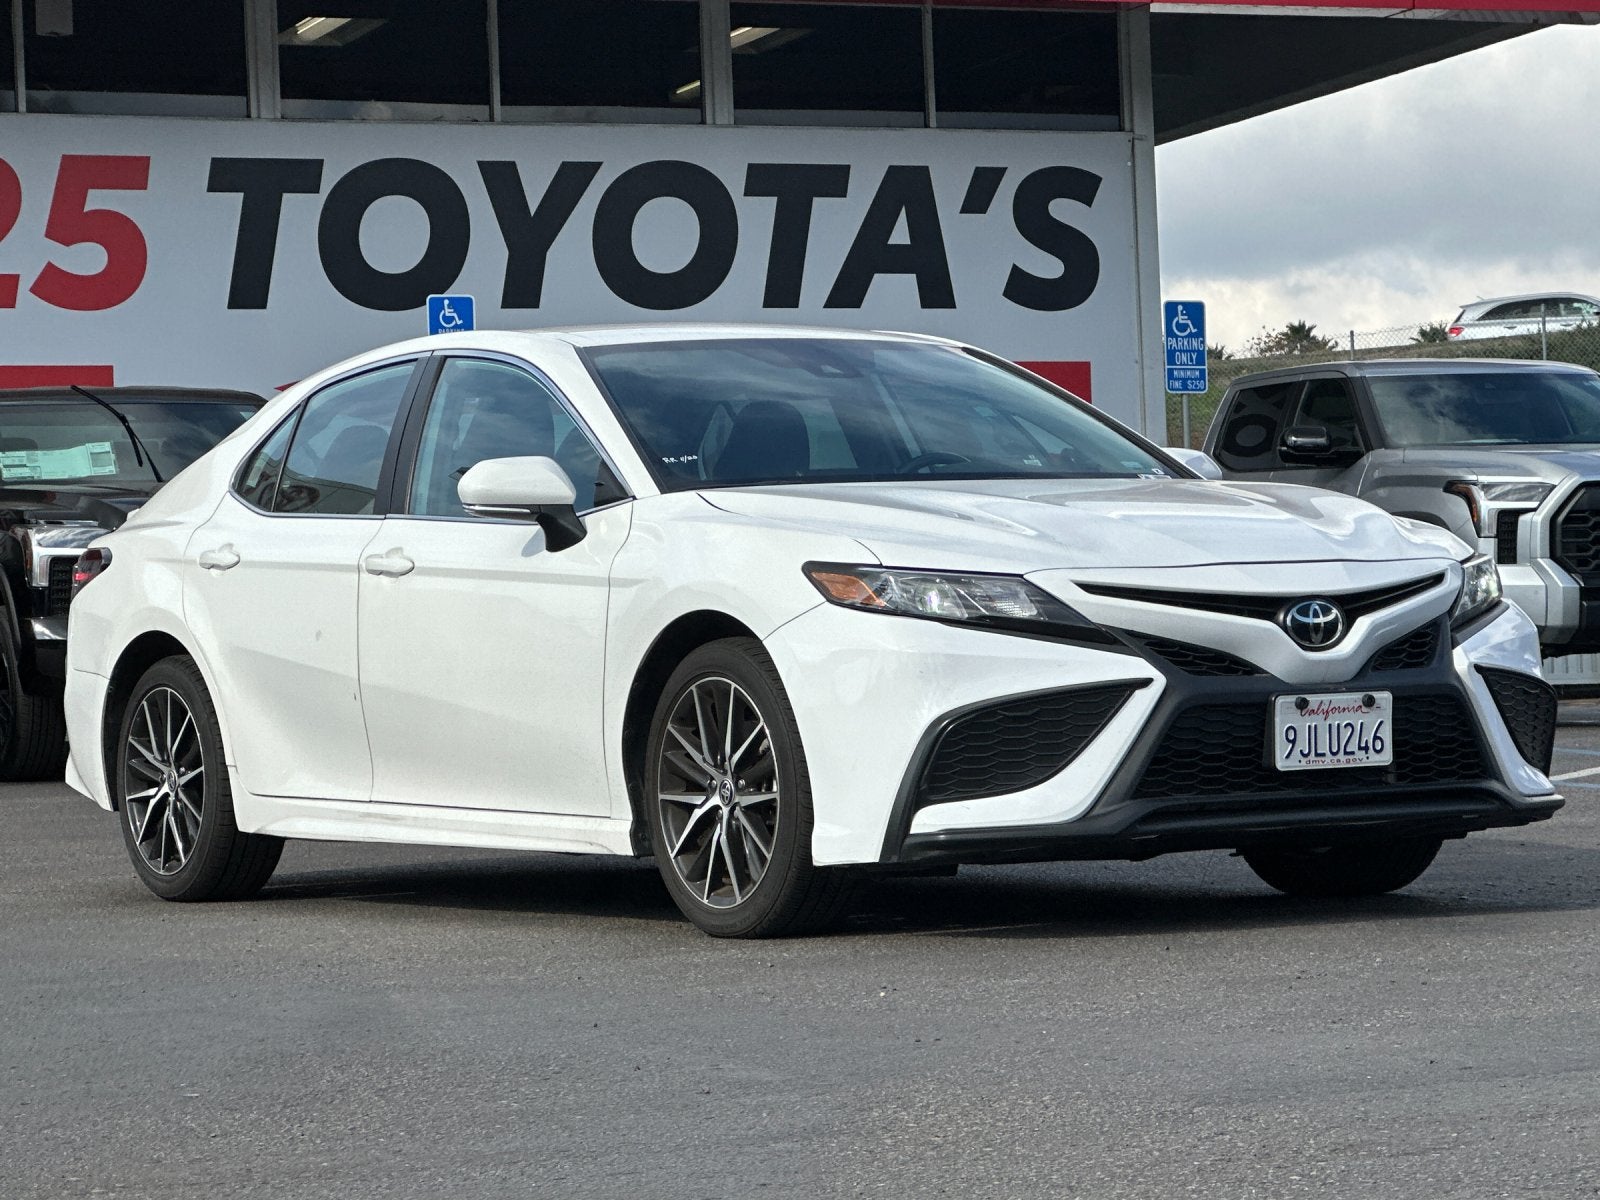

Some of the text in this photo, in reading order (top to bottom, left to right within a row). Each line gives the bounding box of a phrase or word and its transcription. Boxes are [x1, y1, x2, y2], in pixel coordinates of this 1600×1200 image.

[206, 157, 1103, 312] TOYOTA'S
[1167, 337, 1204, 350] PARKING
[1175, 352, 1197, 365] ONLY
[1173, 369, 1200, 379] MINIMUM
[1169, 379, 1205, 390] FINE $250
[1284, 719, 1385, 759] 9JLU246
[1305, 757, 1364, 765] dmv.ca.gov
